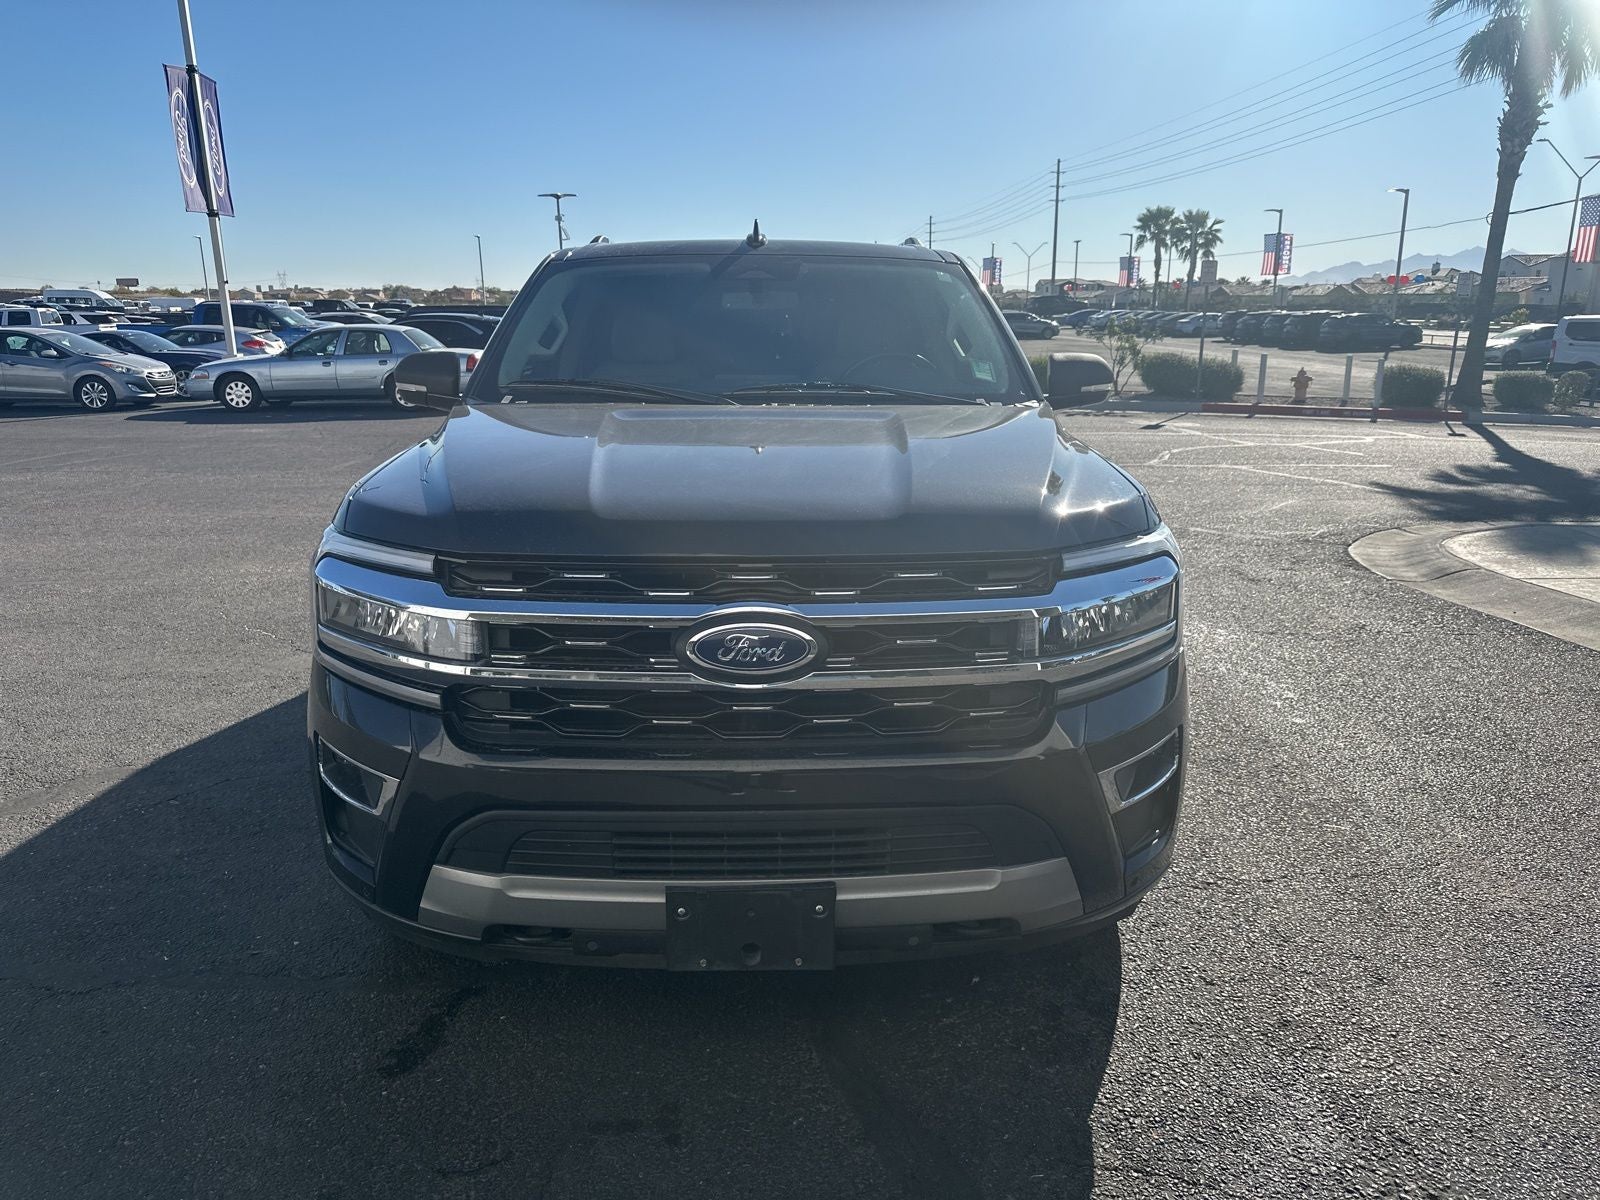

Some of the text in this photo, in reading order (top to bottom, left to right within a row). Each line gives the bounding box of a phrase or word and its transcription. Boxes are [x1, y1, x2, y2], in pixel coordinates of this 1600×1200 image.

[175, 110, 190, 165] Ford
[207, 122, 221, 176] Ford
[717, 633, 787, 662] Ford
